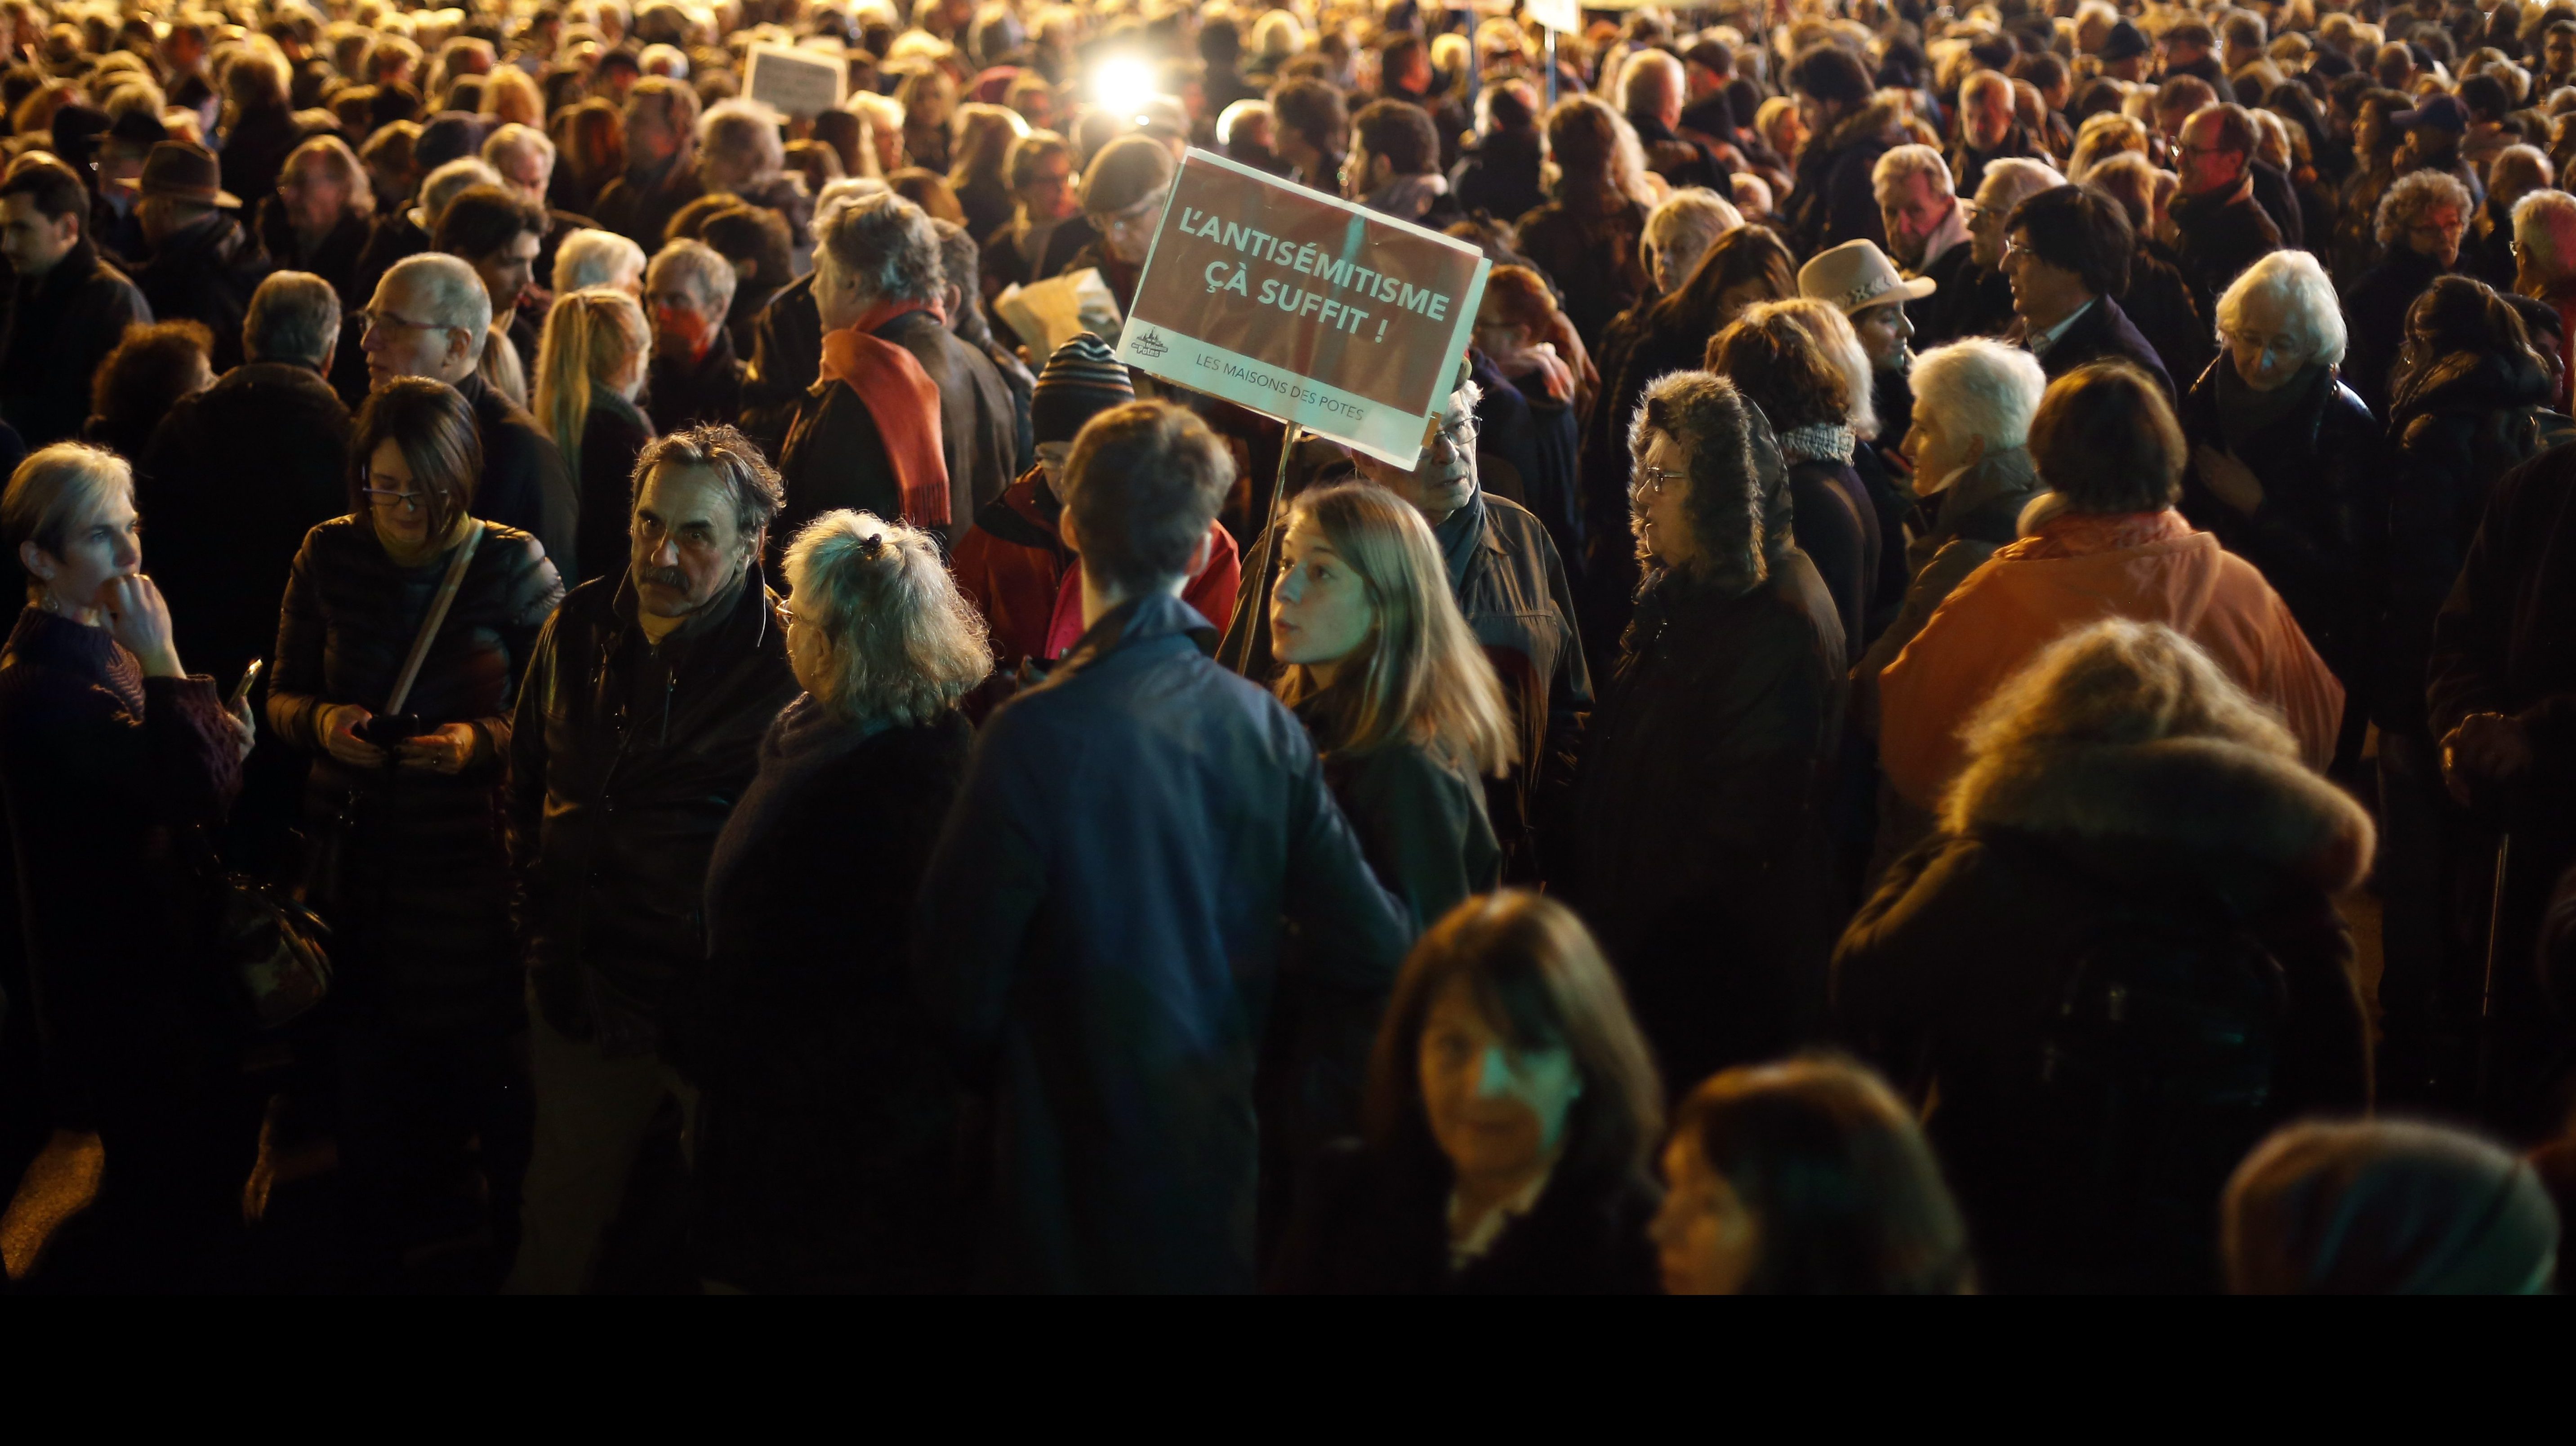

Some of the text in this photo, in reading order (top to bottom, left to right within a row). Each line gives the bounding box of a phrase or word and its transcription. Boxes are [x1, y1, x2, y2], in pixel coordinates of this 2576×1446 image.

[1205, 261, 1388, 343] ÇÀ SUFFIT !
[1196, 353, 1364, 421] LES MAISONS DES POTES
